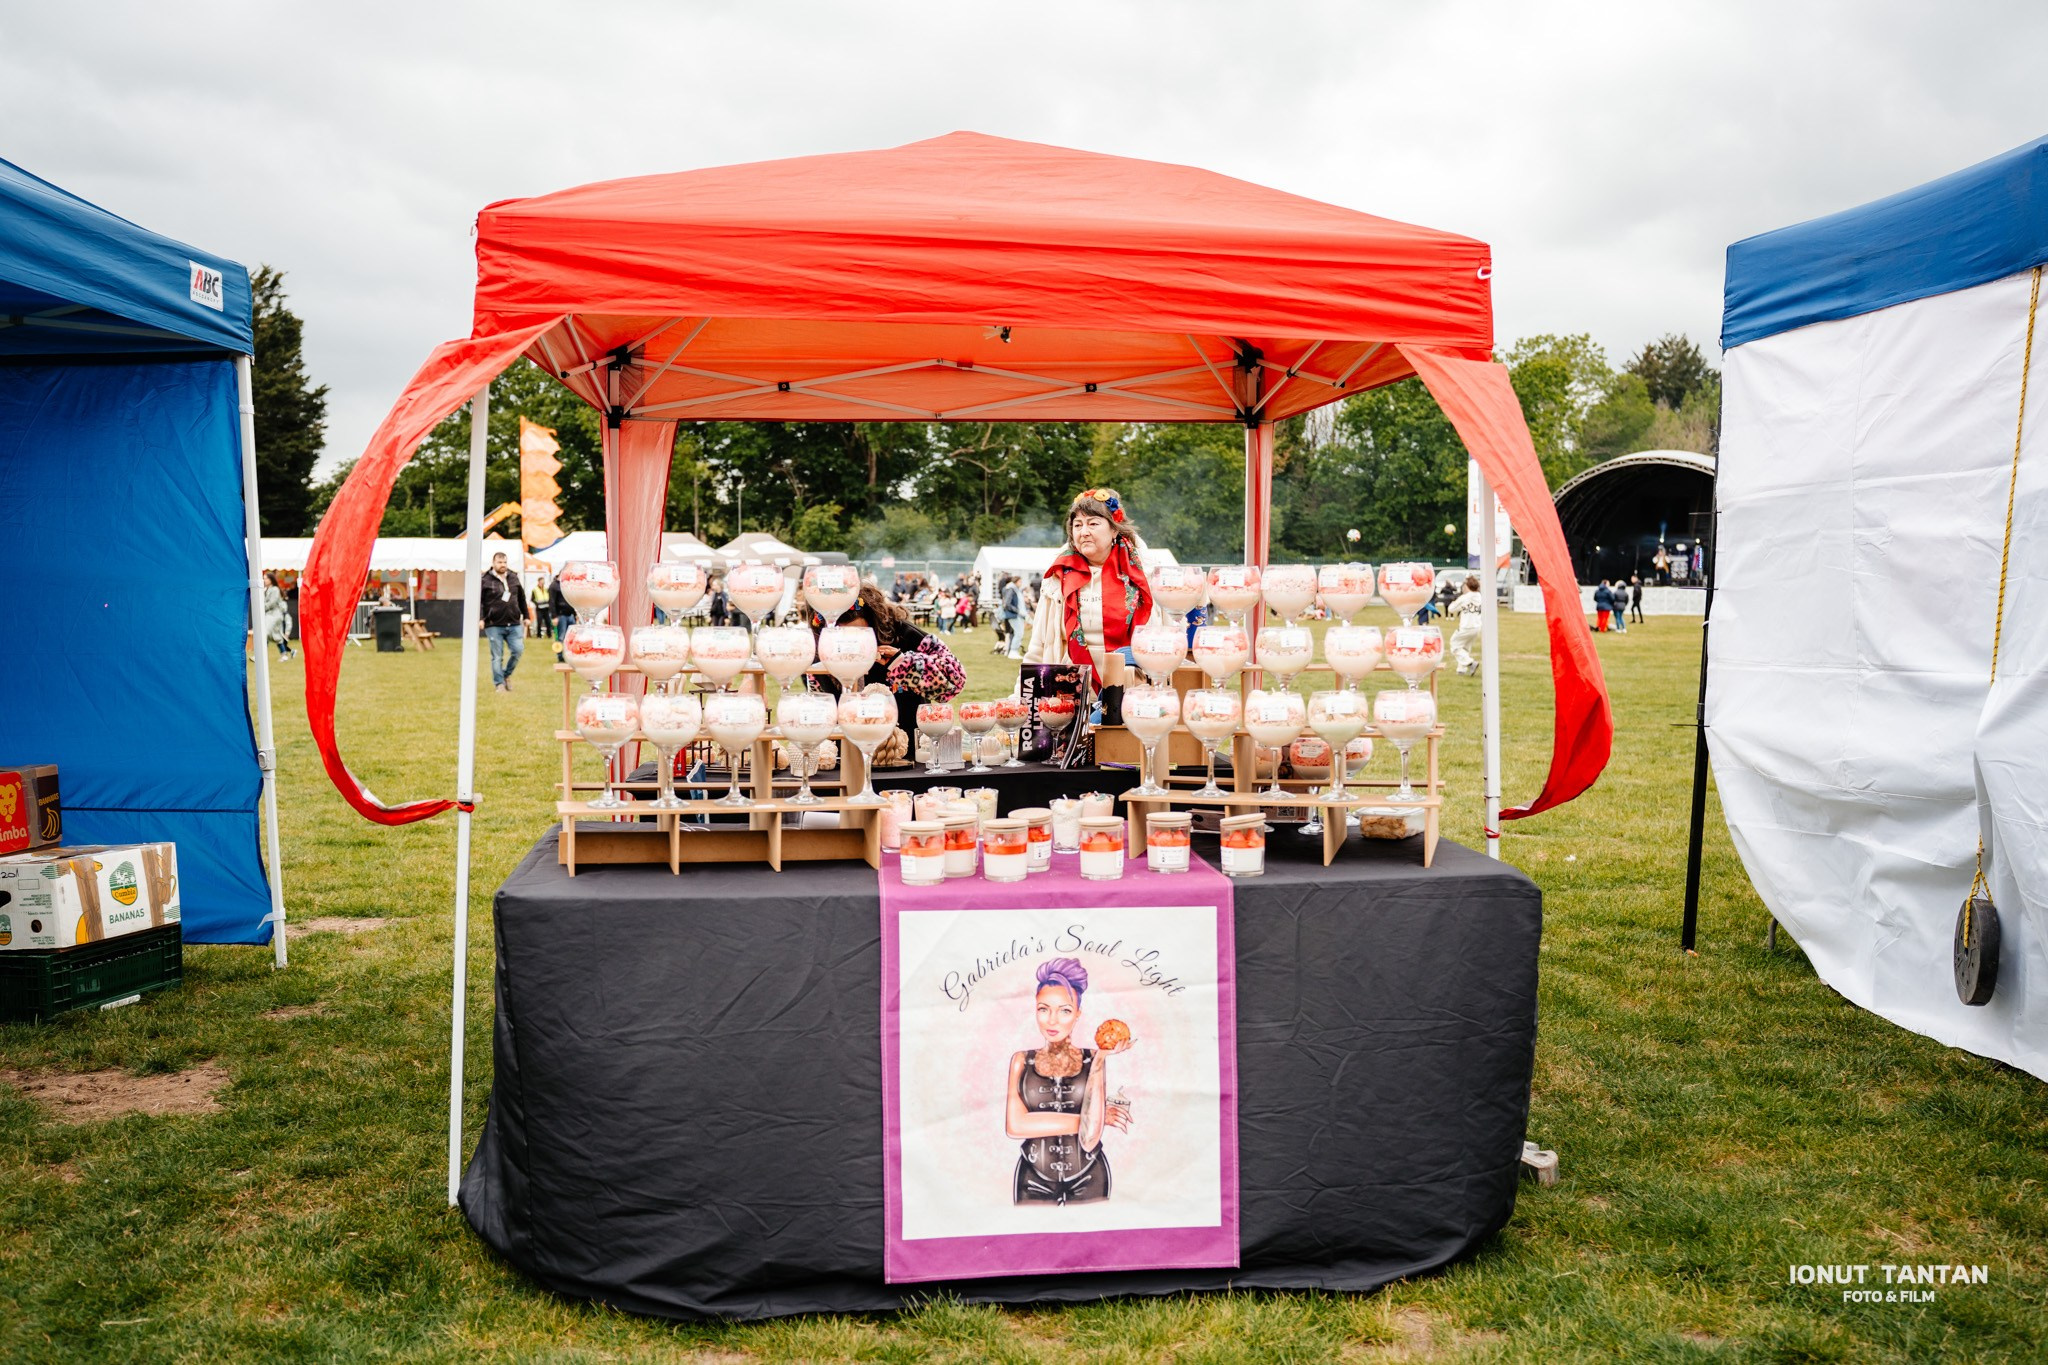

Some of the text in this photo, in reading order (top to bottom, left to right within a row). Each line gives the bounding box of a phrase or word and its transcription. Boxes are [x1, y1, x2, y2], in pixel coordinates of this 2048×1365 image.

[193, 269, 219, 297] ABC
[0, 826, 27, 842] imba
[109, 908, 145, 924] BANANAS
[939, 925, 1185, 1012] Gabriela's Soul Light
